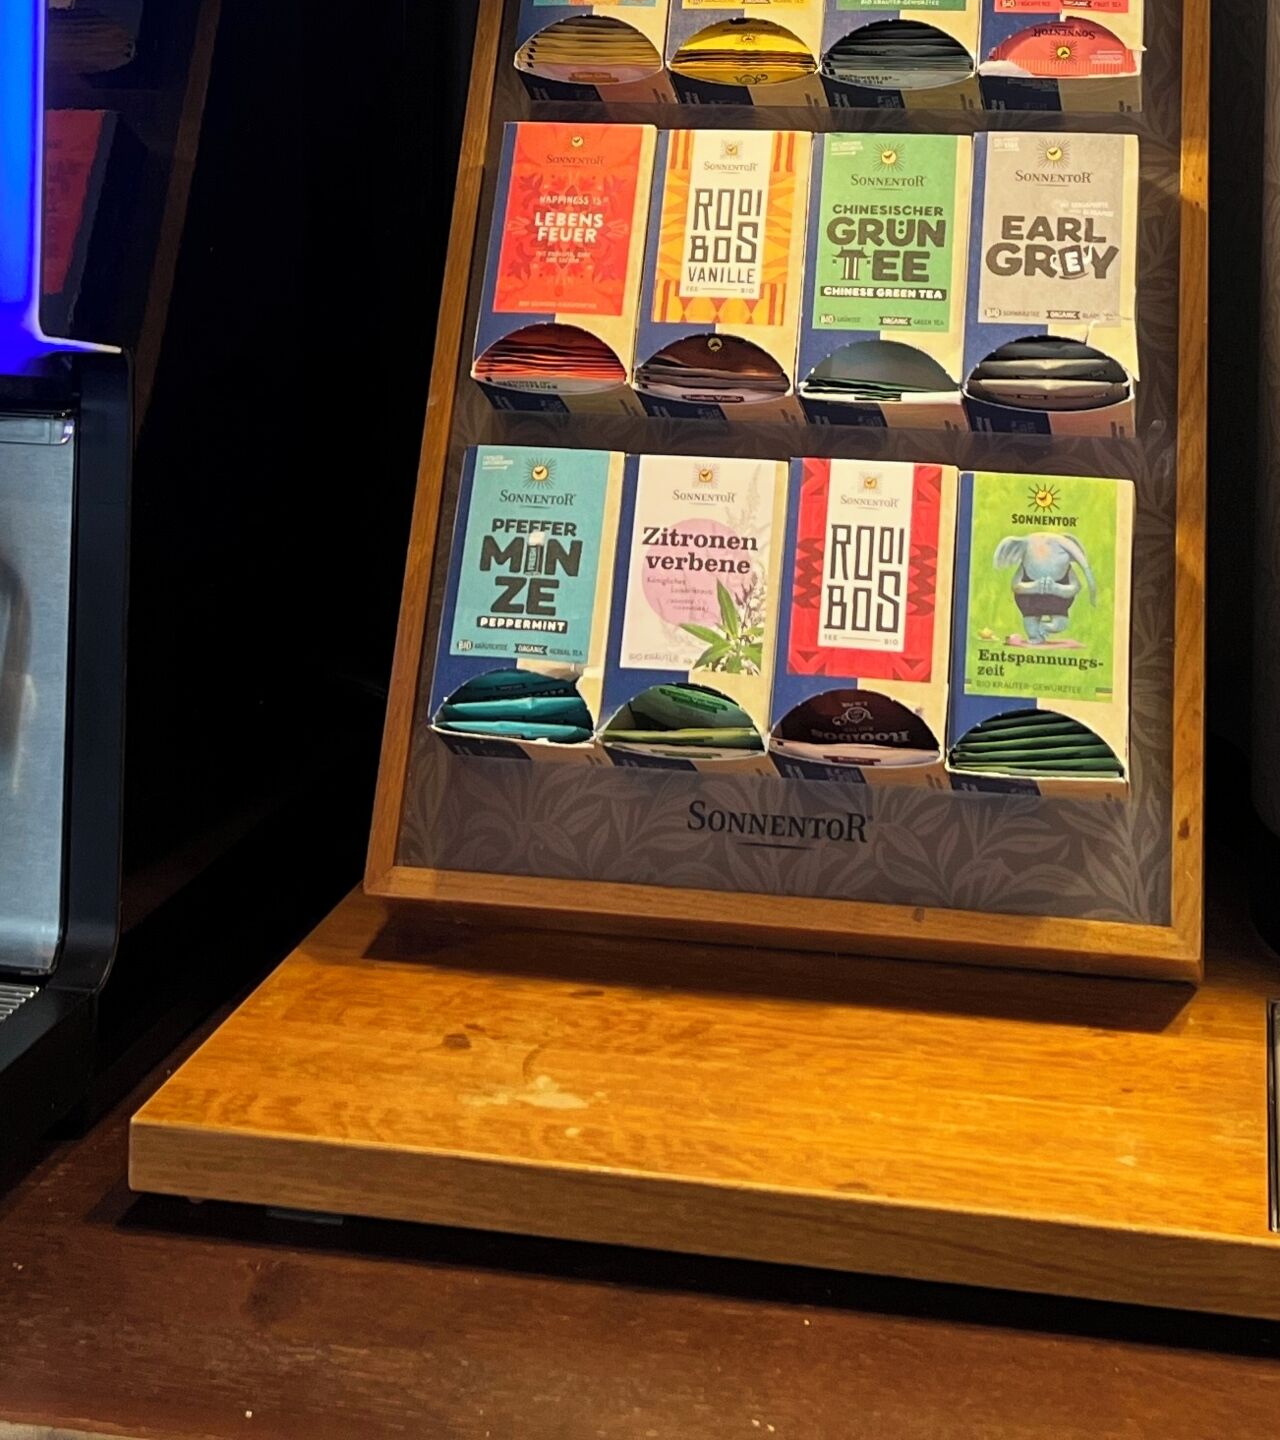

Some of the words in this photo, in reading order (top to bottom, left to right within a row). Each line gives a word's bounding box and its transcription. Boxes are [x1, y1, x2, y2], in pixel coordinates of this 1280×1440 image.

[851, 173, 926, 188] SONNENTOR
[1015, 169, 1093, 184] SONNENTOR
[534, 211, 604, 228] LEBENS
[832, 203, 944, 217] CHINESISCHER
[537, 227, 598, 243] FEUER
[826, 216, 947, 248] GRÜN
[1001, 215, 1107, 244] EARL
[831, 246, 931, 282] TEE
[985, 242, 1120, 280] GREY
[688, 266, 756, 285] VANILLE
[823, 286, 875, 297] CHINESE
[876, 288, 917, 299] GREEN
[918, 289, 944, 300] TEA
[499, 489, 576, 506] SONNENTOR
[672, 489, 737, 504] SONNENTOR
[491, 517, 577, 537] PFEFFER
[1011, 513, 1079, 527] SONNENTOR
[642, 526, 759, 552] Zitronen
[479, 534, 584, 578] MIN
[646, 552, 751, 575] verbene
[490, 576, 560, 617] ZE
[479, 616, 566, 633] PEPPERMINT
[977, 648, 1104, 671] Entspannungs-
[977, 663, 1005, 677] zeit
[686, 799, 869, 845] SONNENTOR
